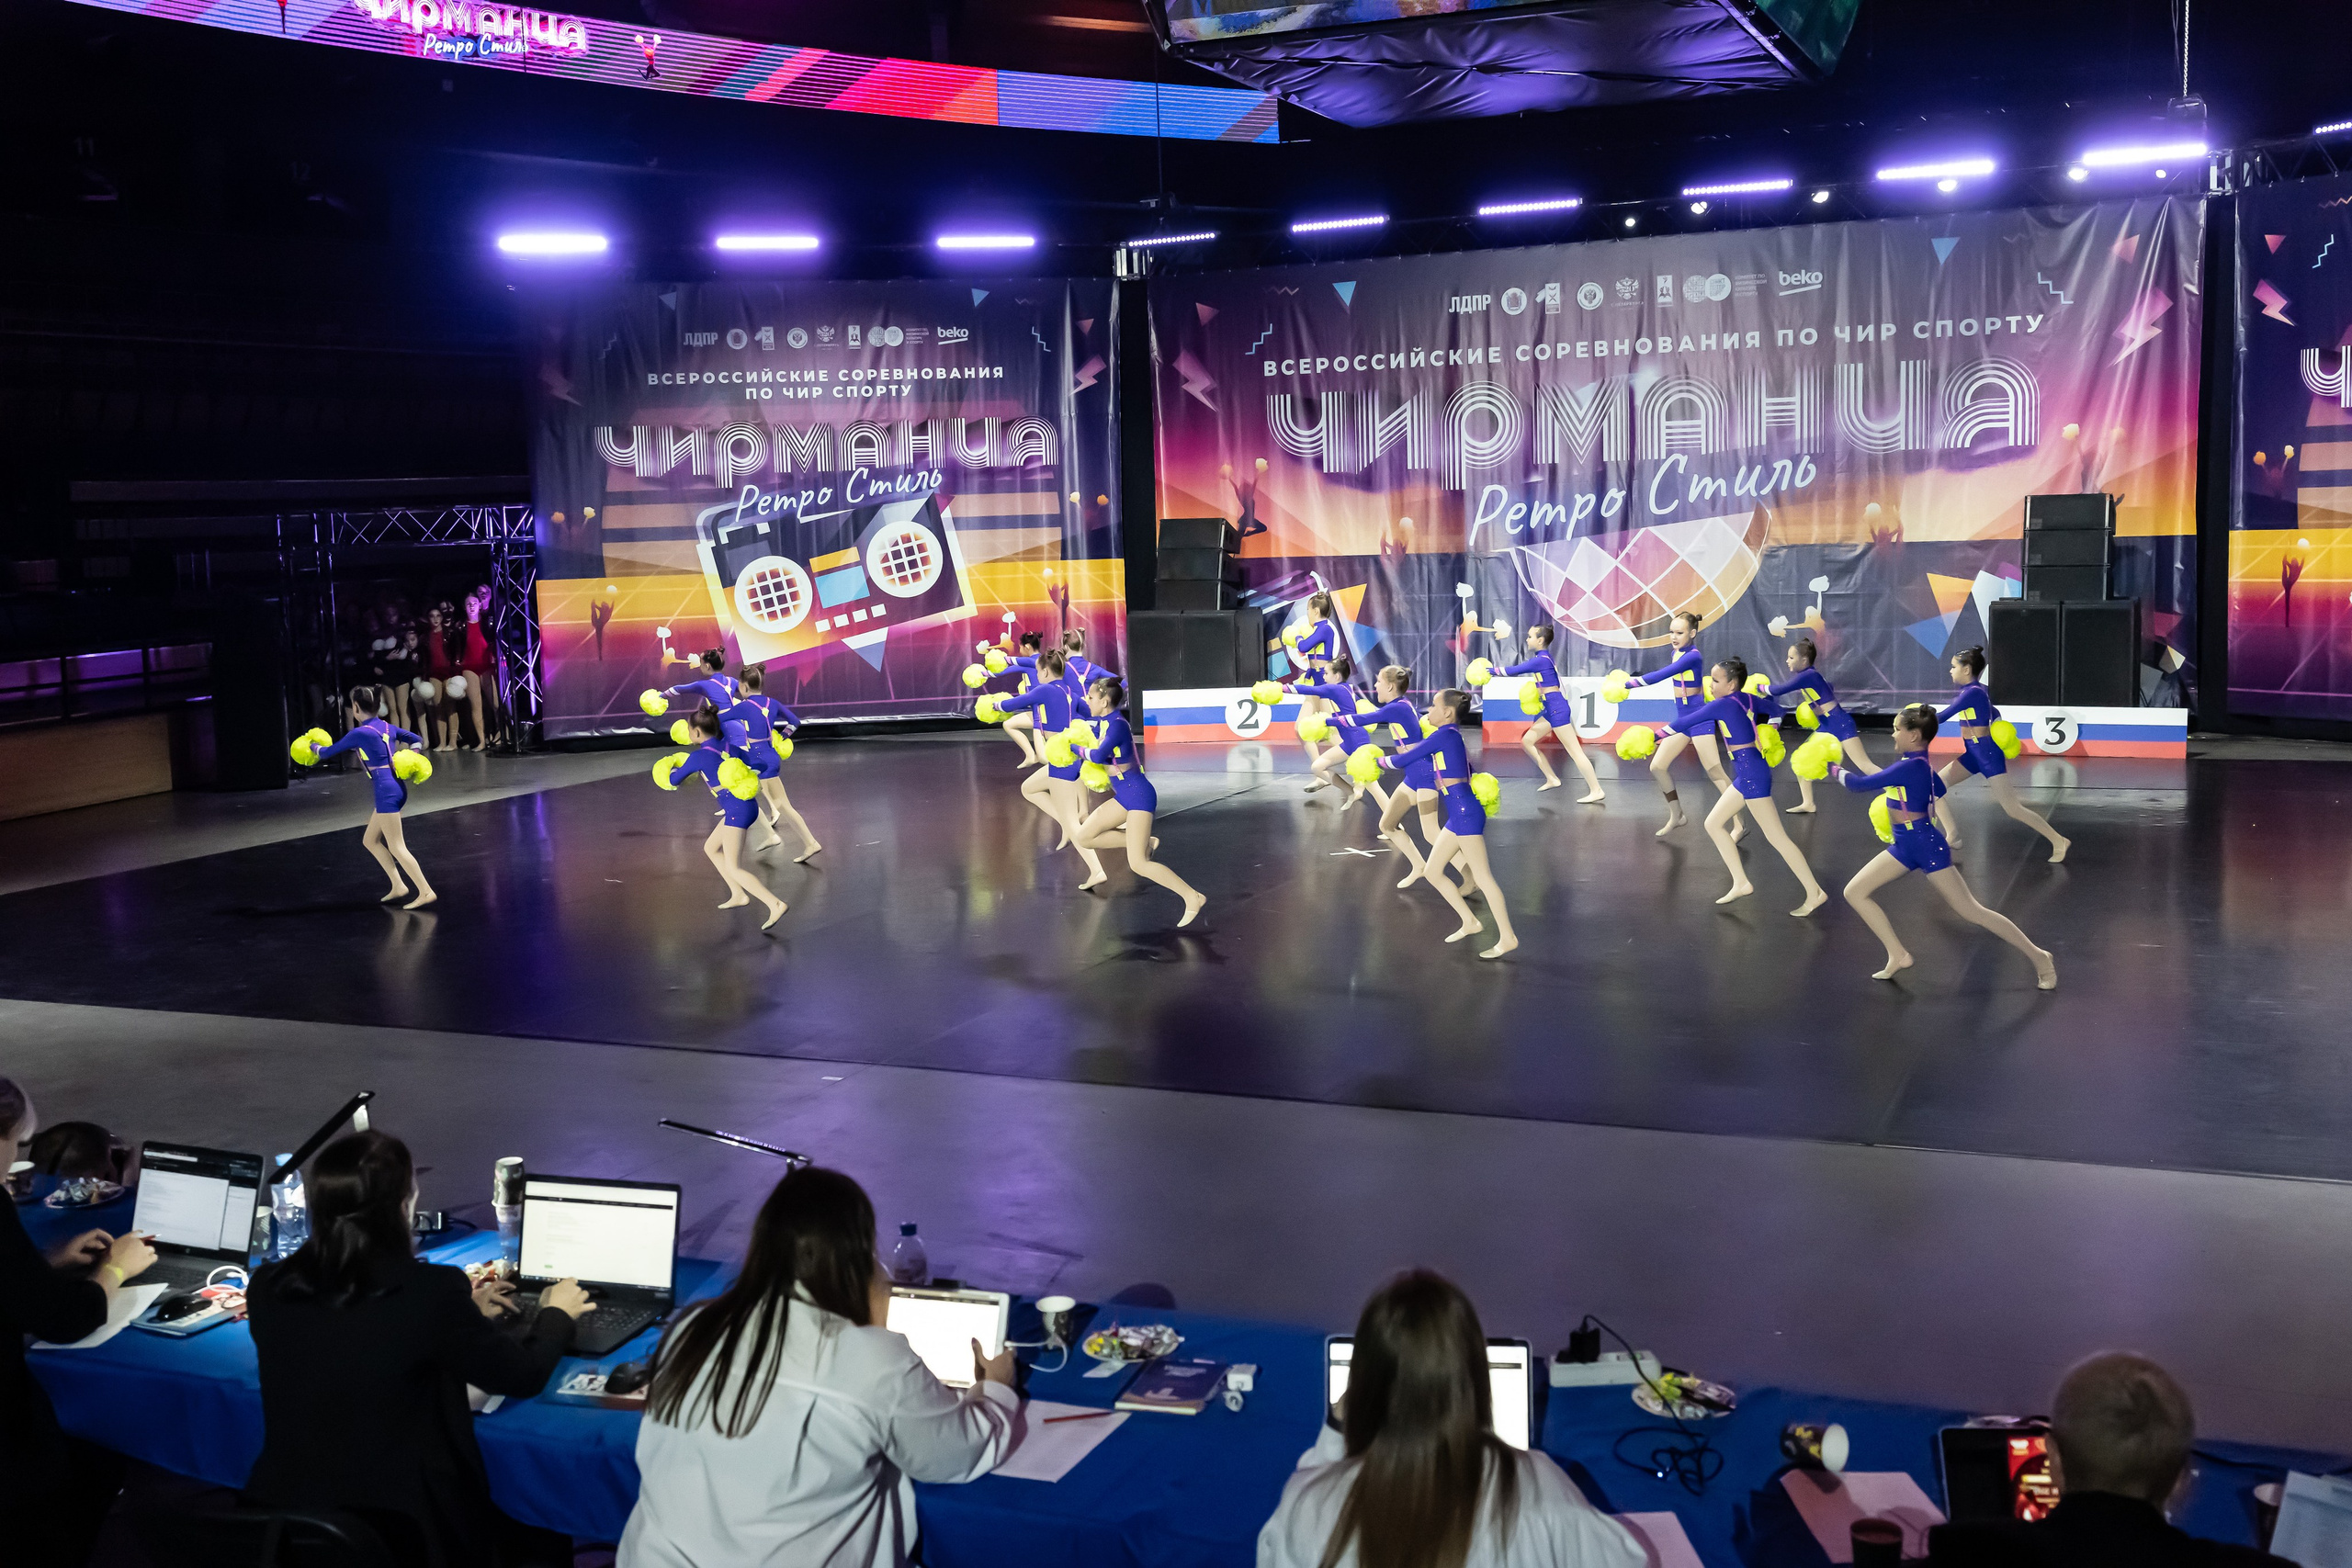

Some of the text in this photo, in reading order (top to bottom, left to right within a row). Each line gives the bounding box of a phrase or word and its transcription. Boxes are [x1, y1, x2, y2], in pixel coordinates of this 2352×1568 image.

[424, 33, 474, 60] Ретро
[1779, 269, 1823, 286] beko
[1449, 295, 1491, 314] ЛДПР
[684, 332, 718, 347] ЛДПР
[937, 326, 968, 338] beko
[1263, 313, 2044, 377] ВСЕРОССИЙСКИЕ СОРЕВНОВАНИЯ ПО ЧИР СПОРТУ
[648, 367, 1004, 386] ВСЕРОССИЙСКИЕ СОРЕВНОВАНИЯ
[745, 384, 912, 400] ПО ЧИР СПОРТУ
[736, 466, 943, 522] Ретро Стиль
[1470, 453, 1816, 546] Ретро Стиль
[1237, 698, 1260, 729] 2
[1580, 696, 1600, 728] 1
[2044, 716, 2066, 745] 3
